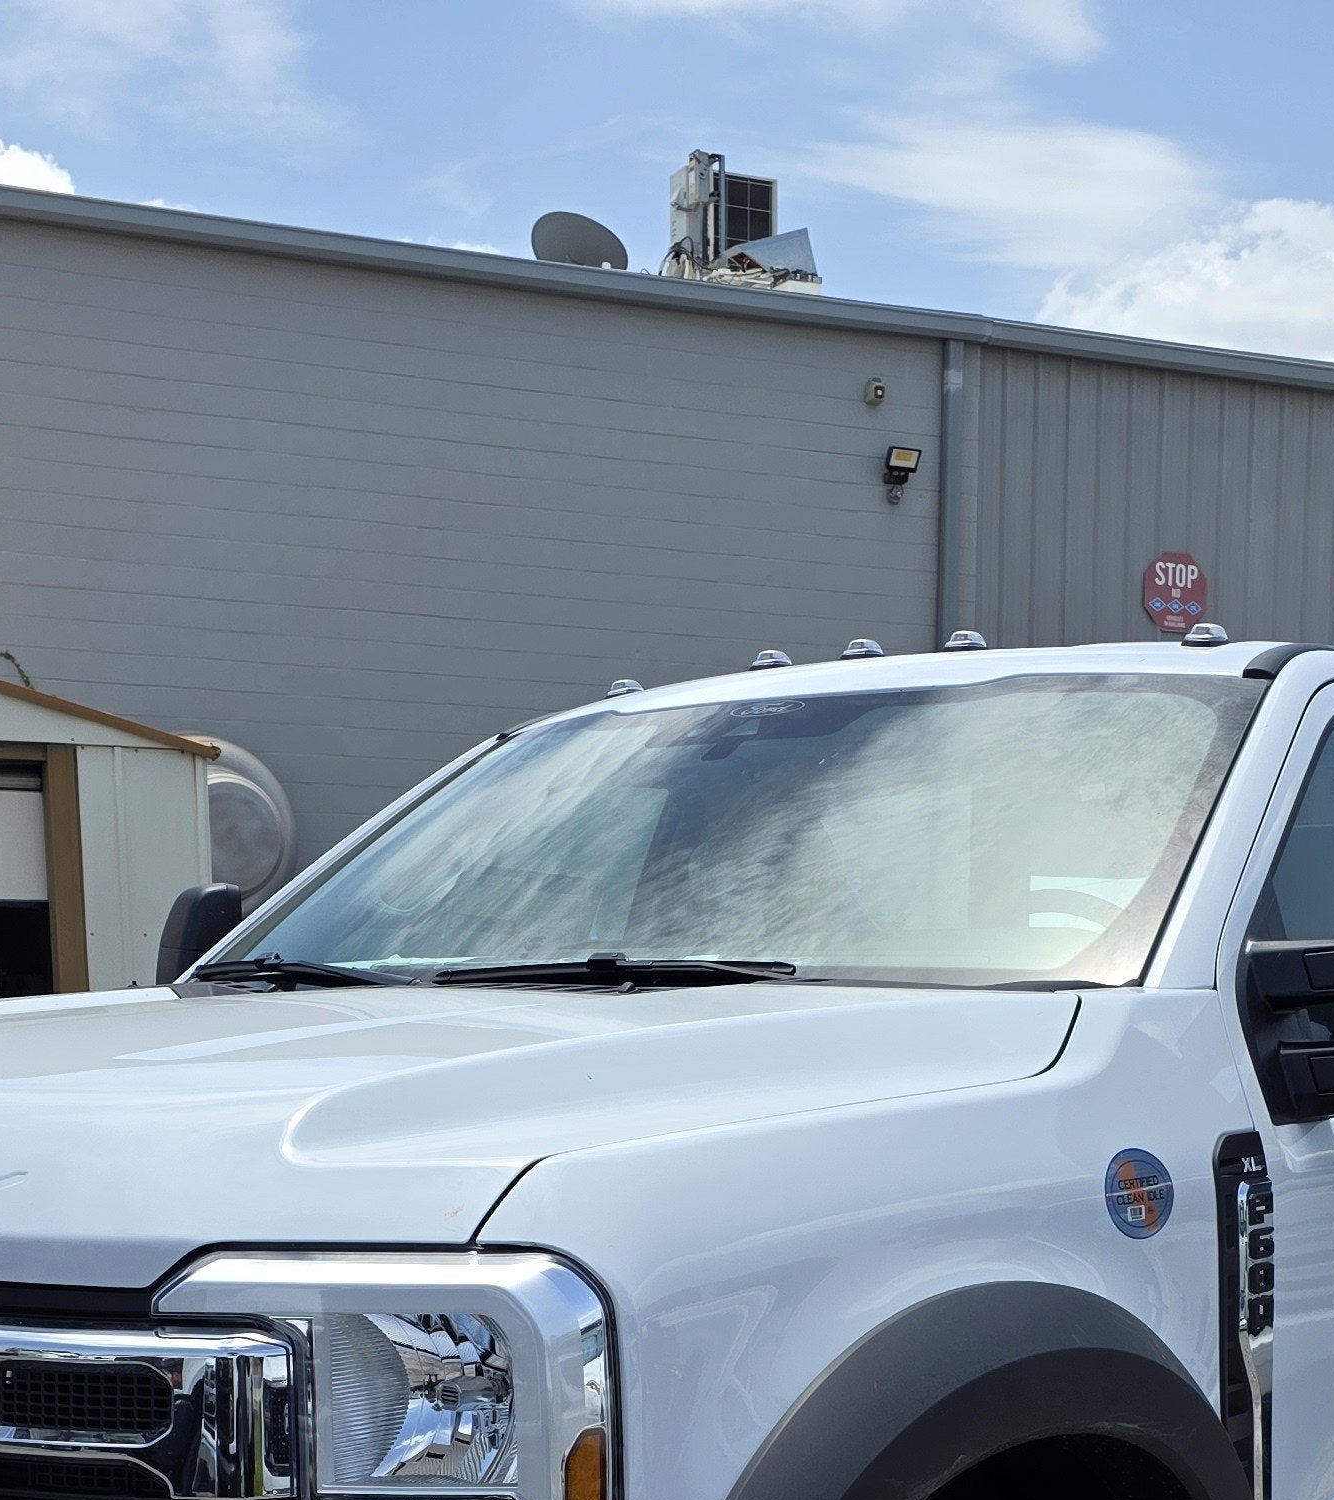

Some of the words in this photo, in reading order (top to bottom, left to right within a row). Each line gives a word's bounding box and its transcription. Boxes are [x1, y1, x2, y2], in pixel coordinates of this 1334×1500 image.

[1154, 561, 1199, 589] STOP
[1241, 1156, 1265, 1173] XL
[1116, 1191, 1145, 1206] CLEAN
